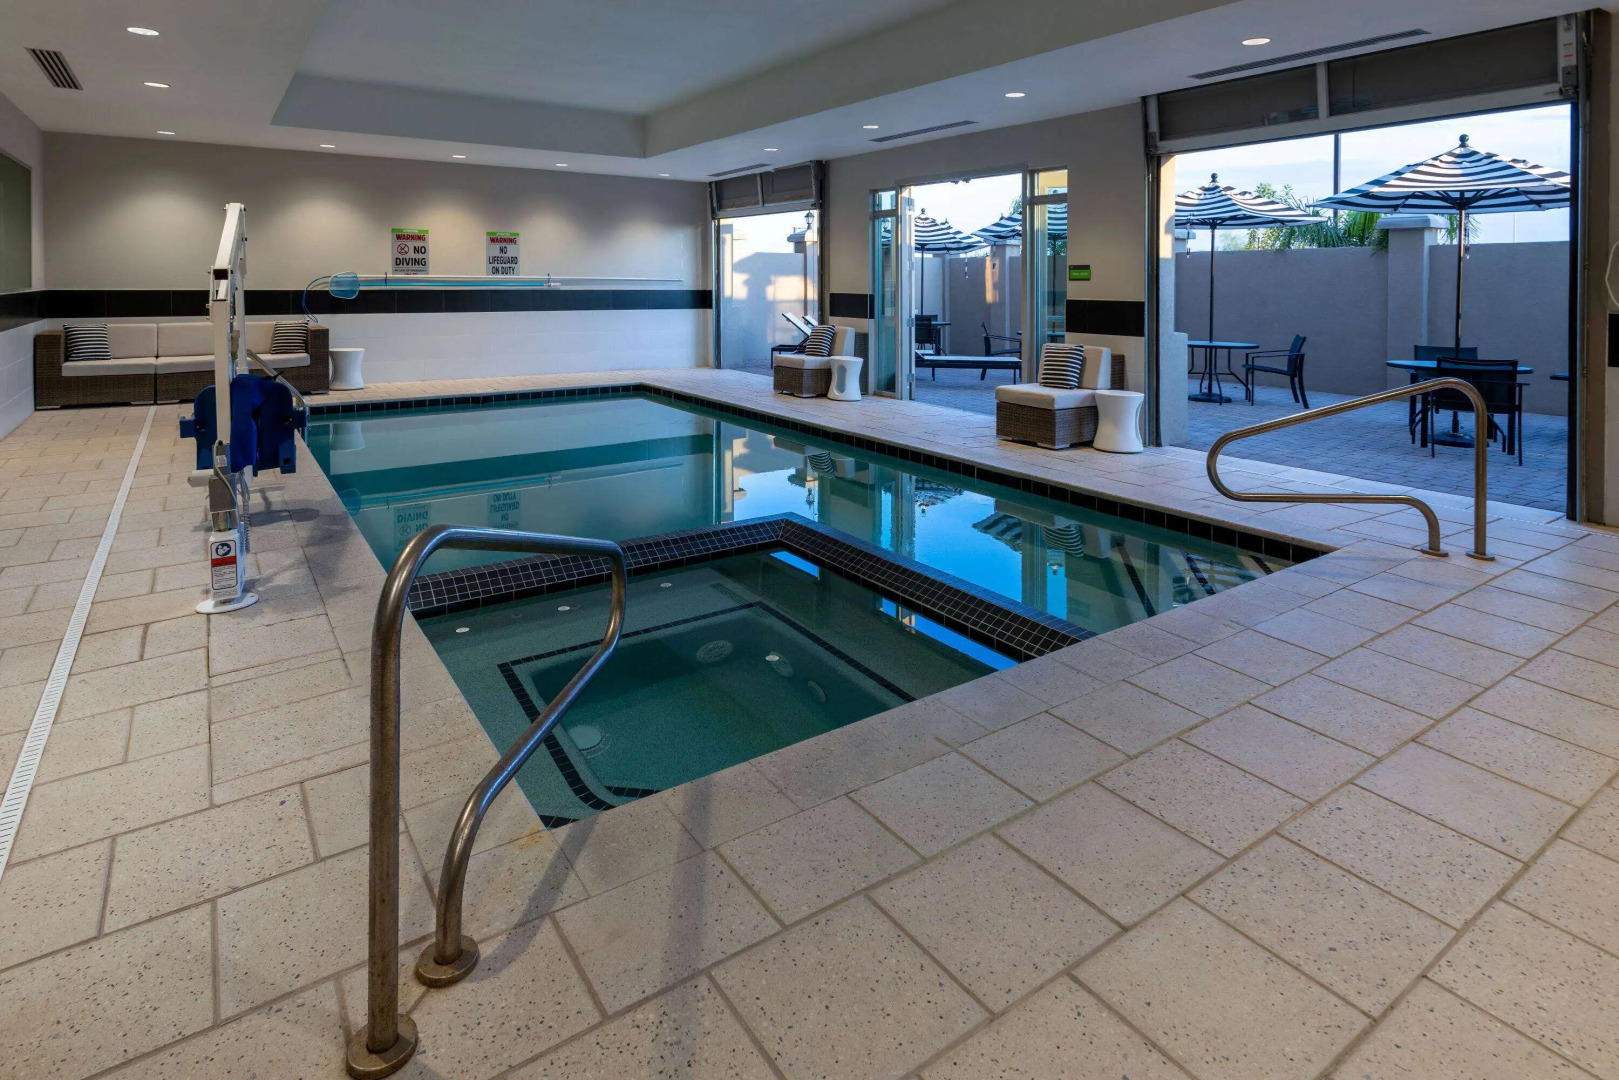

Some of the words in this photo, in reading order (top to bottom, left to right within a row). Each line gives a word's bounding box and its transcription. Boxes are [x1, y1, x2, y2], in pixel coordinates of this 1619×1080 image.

[413, 246, 426, 254] NO
[499, 245, 508, 254] NO
[395, 257, 427, 266] DIVING
[488, 256, 518, 265] LIFEGUARD
[492, 266, 500, 275] ON
[500, 266, 516, 275] DUTY
